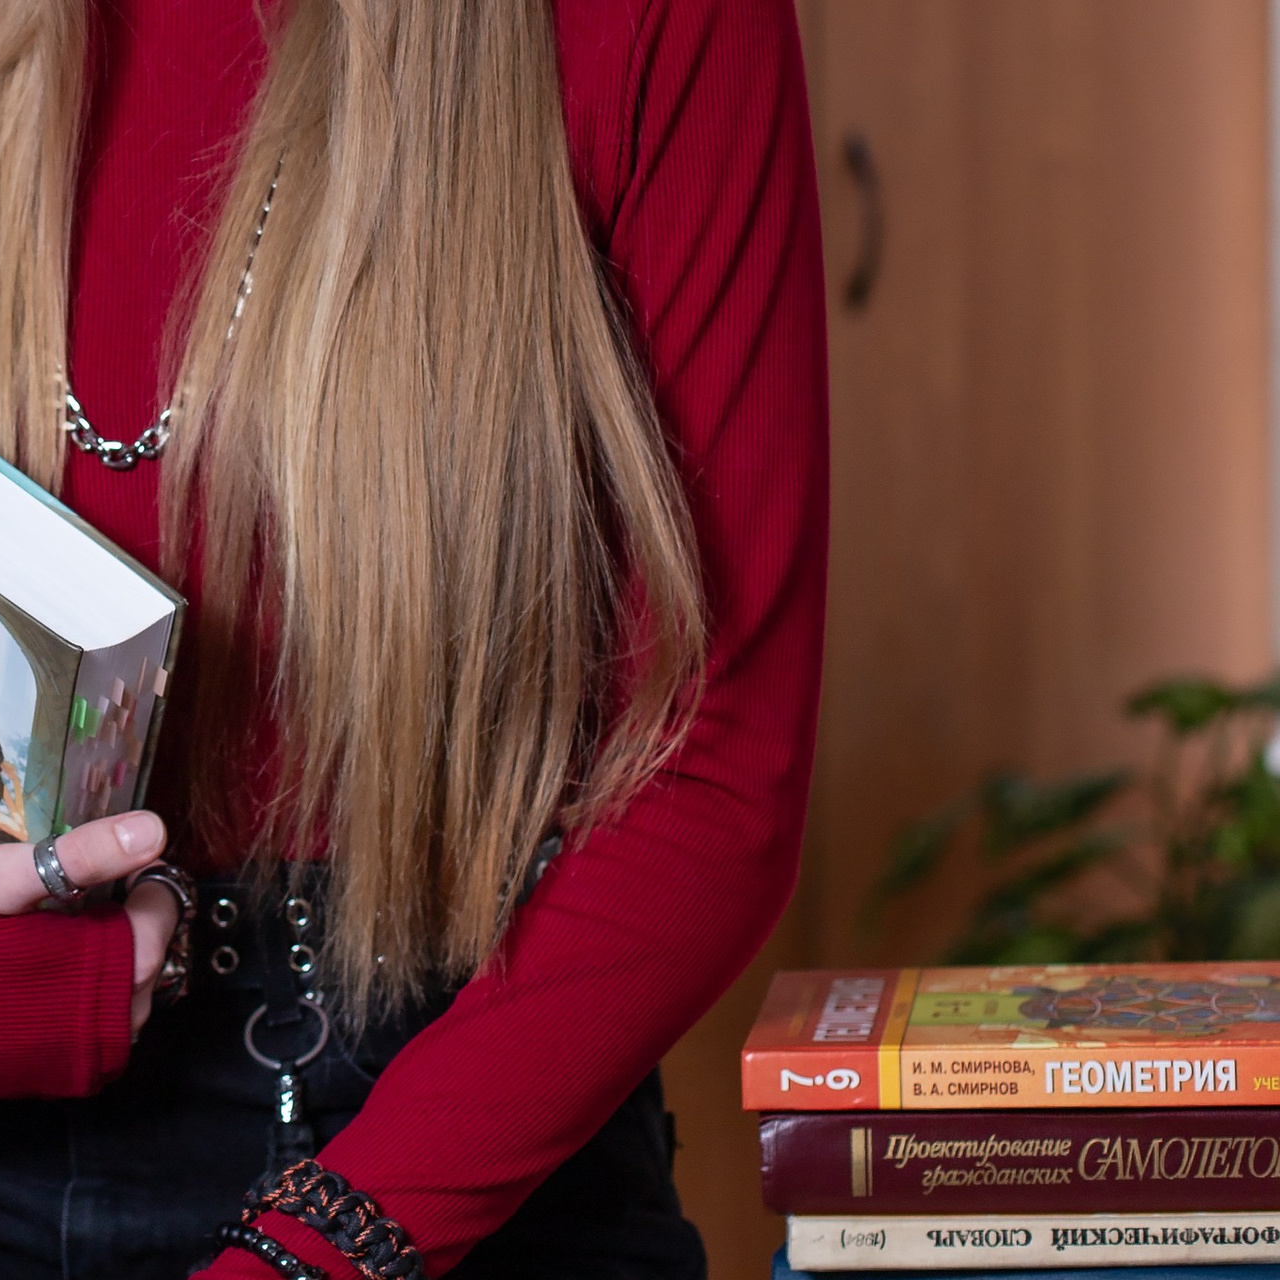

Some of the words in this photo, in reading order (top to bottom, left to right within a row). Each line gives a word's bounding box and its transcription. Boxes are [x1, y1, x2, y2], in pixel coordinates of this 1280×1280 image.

[913, 1061, 927, 1075] И.
[931, 1061, 947, 1075] М.
[951, 1060, 1036, 1076] СМИРНОВА,
[1045, 1059, 1238, 1095] ГЕОМЕТРИЯ
[913, 1083, 927, 1096] В.
[931, 1082, 943, 1096] А.
[948, 1082, 1019, 1096] СМИРНОВ
[884, 1133, 1072, 1169] Проектирование
[1078, 1136, 1280, 1182] САМОЛЕТО
[922, 1162, 1074, 1196] гражданских
[927, 1228, 1032, 1248] СЛОВАРЬ
